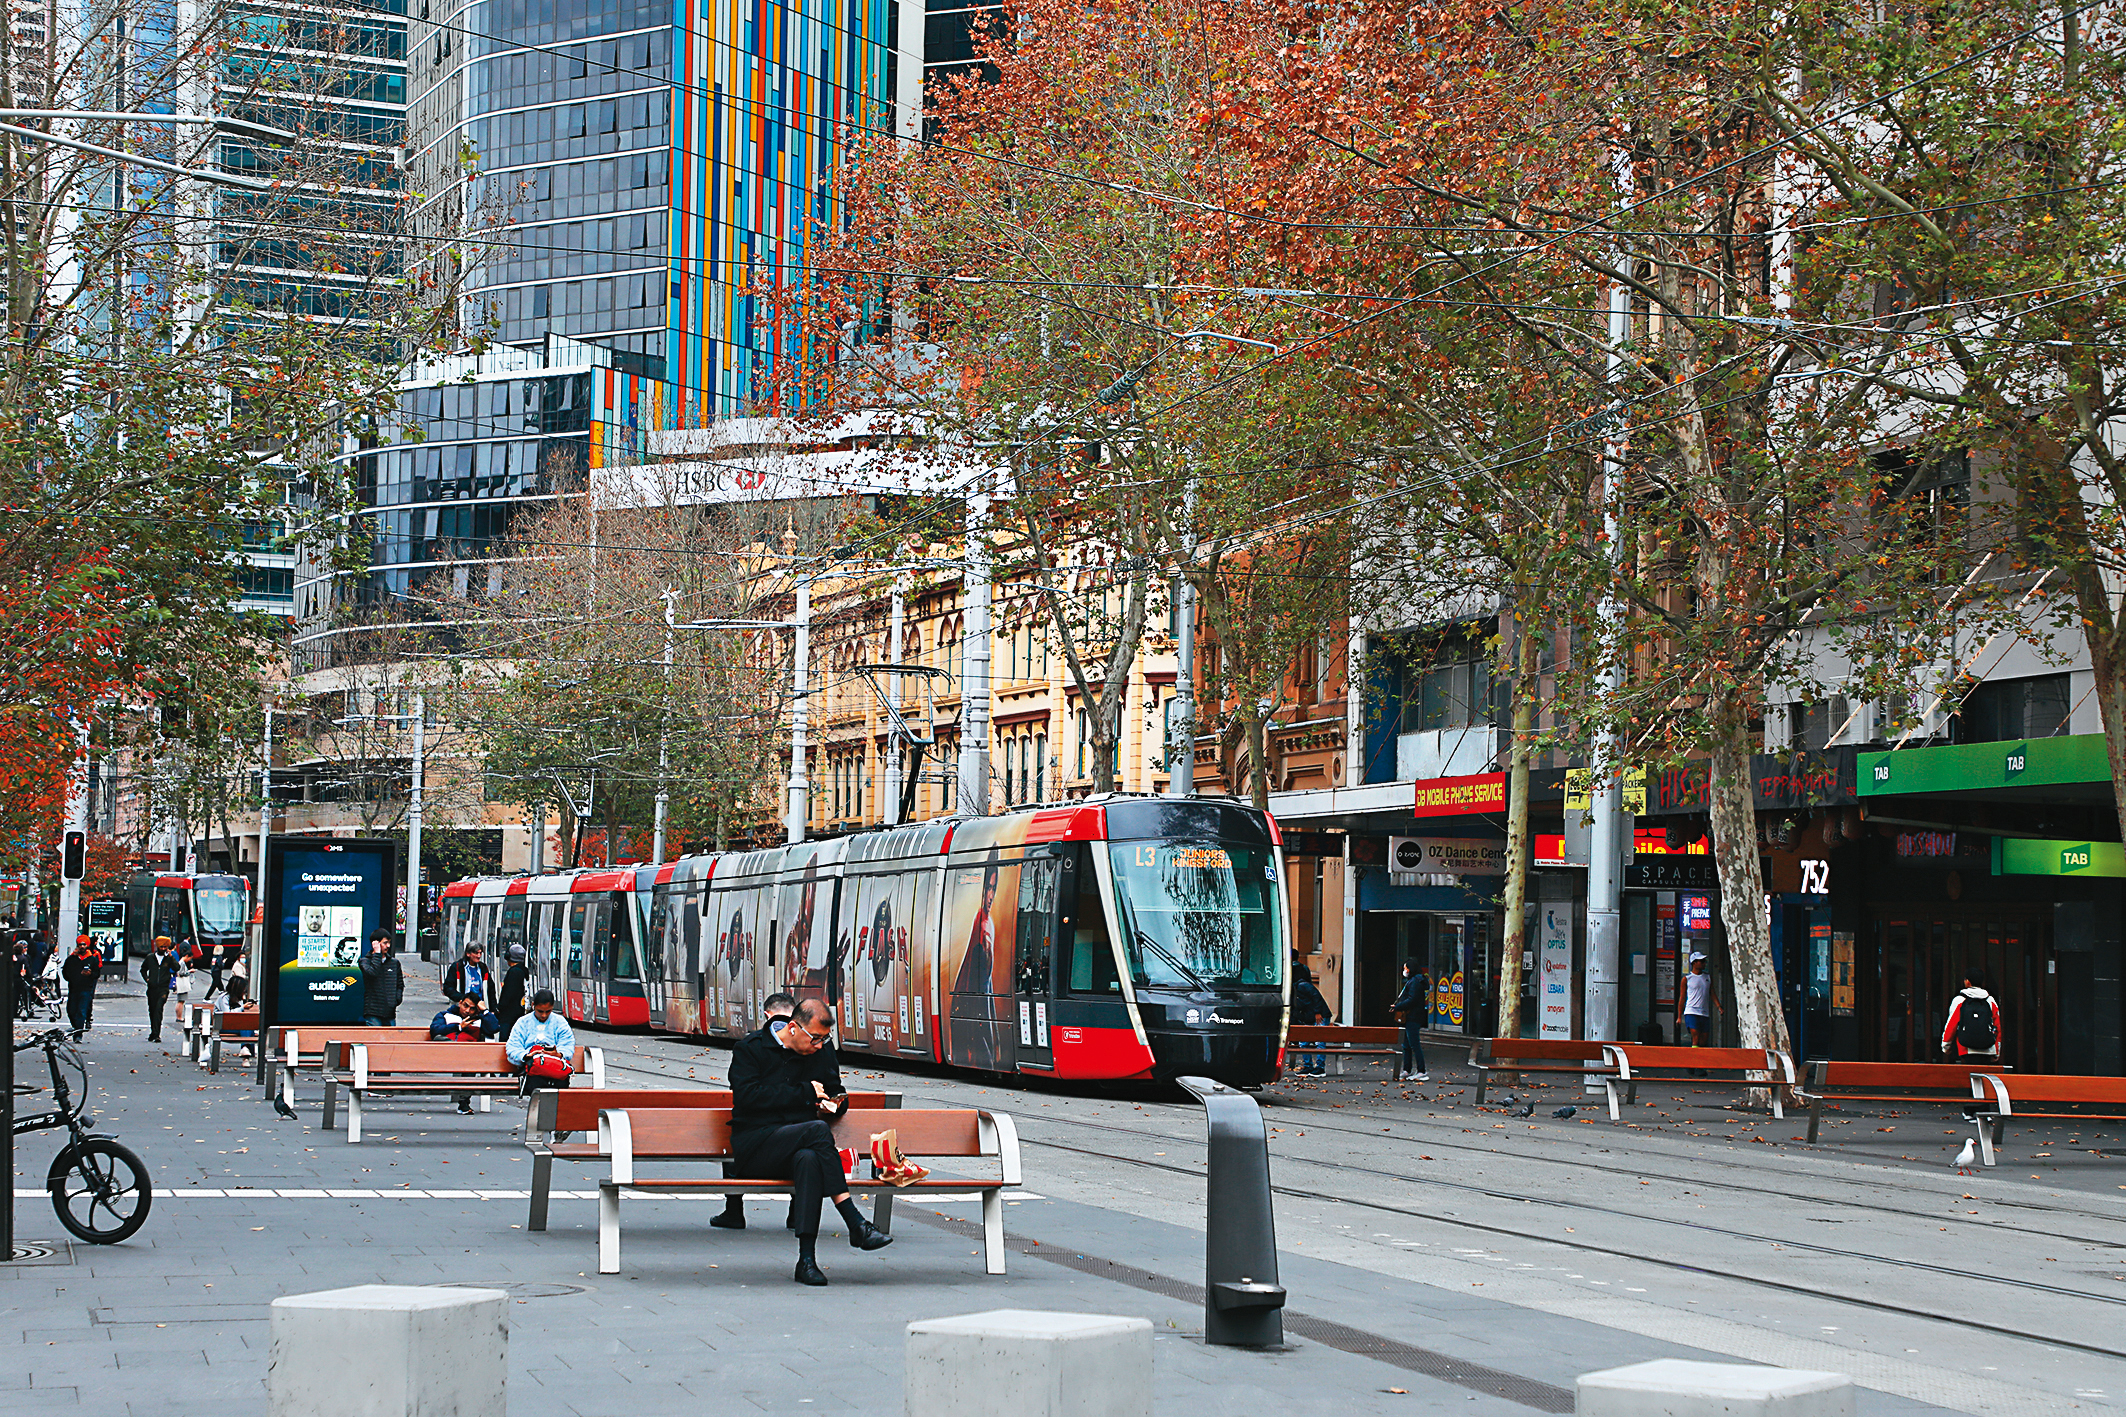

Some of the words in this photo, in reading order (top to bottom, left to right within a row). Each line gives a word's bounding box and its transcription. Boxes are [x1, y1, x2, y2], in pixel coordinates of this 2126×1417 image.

[675, 470, 732, 494] HSBC
[2007, 756, 2024, 771] TAB
[1874, 766, 1889, 780] TAB
[1426, 787, 1450, 806] MOBILE
[1450, 785, 1474, 804] PHONE
[1474, 782, 1503, 802] SERVICE
[1135, 846, 1156, 867] L3
[1180, 849, 1226, 859] JUNIORS
[1428, 846, 1443, 857] OZ
[1446, 846, 1479, 859] Dance
[1481, 847, 1507, 859] Cent
[2063, 852, 2088, 865] TAB
[1172, 858, 1232, 869] KINGSFORD
[301, 873, 314, 882] Go
[315, 874, 363, 882] somewhere
[1642, 866, 1711, 879] SPACE
[1800, 860, 1829, 894] 752
[200, 890, 209, 898] L2
[308, 884, 356, 893] unexpected
[1691, 918, 1711, 929] REPAIRS
[718, 932, 754, 965] FLASH
[856, 926, 909, 966] FLASH
[1547, 939, 1566, 949] OPTUS
[308, 980, 346, 991] audible
[1547, 983, 1565, 994] LEBARA
[1451, 994, 1463, 1008] SAL
[1547, 1005, 1565, 1015] amaysim
[1220, 1017, 1245, 1025] Transport
